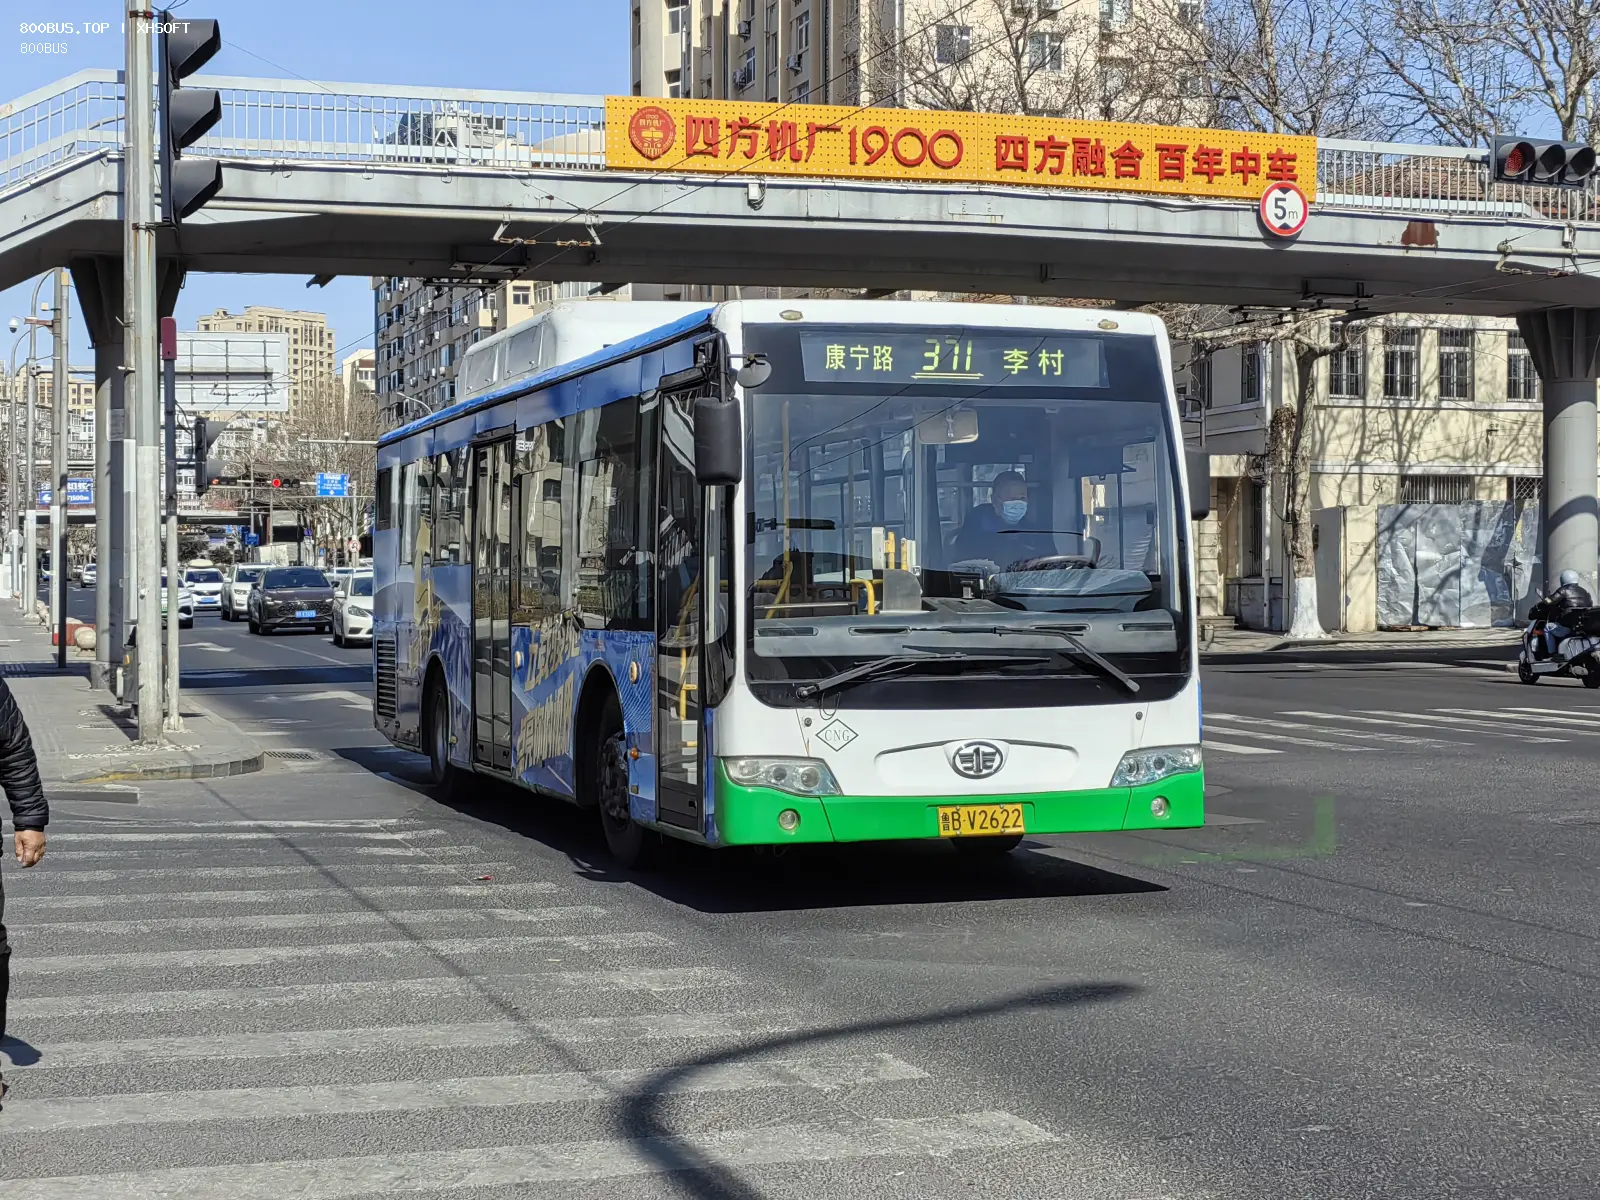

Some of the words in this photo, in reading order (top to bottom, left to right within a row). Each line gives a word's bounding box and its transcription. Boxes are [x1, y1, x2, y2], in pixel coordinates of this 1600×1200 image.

[825, 344, 894, 372] 康宁路
[922, 338, 973, 371] 371
[1003, 348, 1065, 376] 李村
[824, 729, 850, 742] CNG
